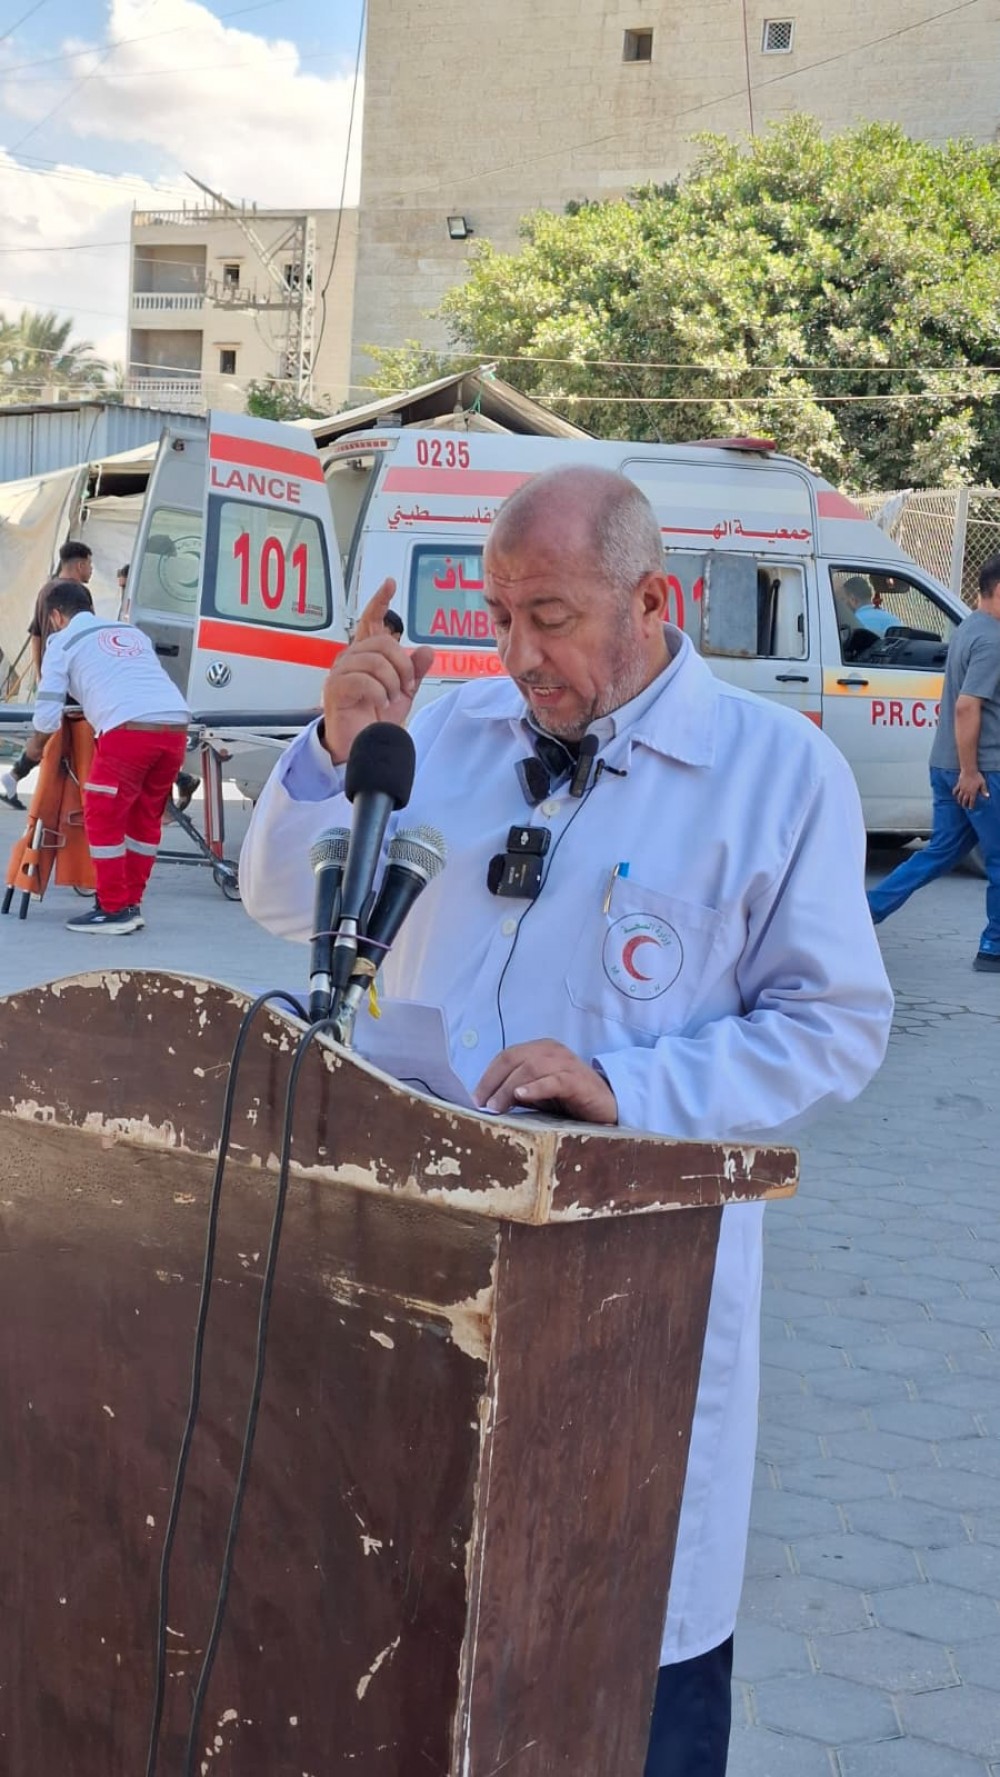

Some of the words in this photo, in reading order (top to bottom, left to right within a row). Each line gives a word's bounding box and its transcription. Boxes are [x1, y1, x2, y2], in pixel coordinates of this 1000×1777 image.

[417, 438, 471, 469] 0235
[210, 465, 301, 503] LANCE
[734, 519, 812, 544] جمعية
[233, 532, 308, 615] 101
